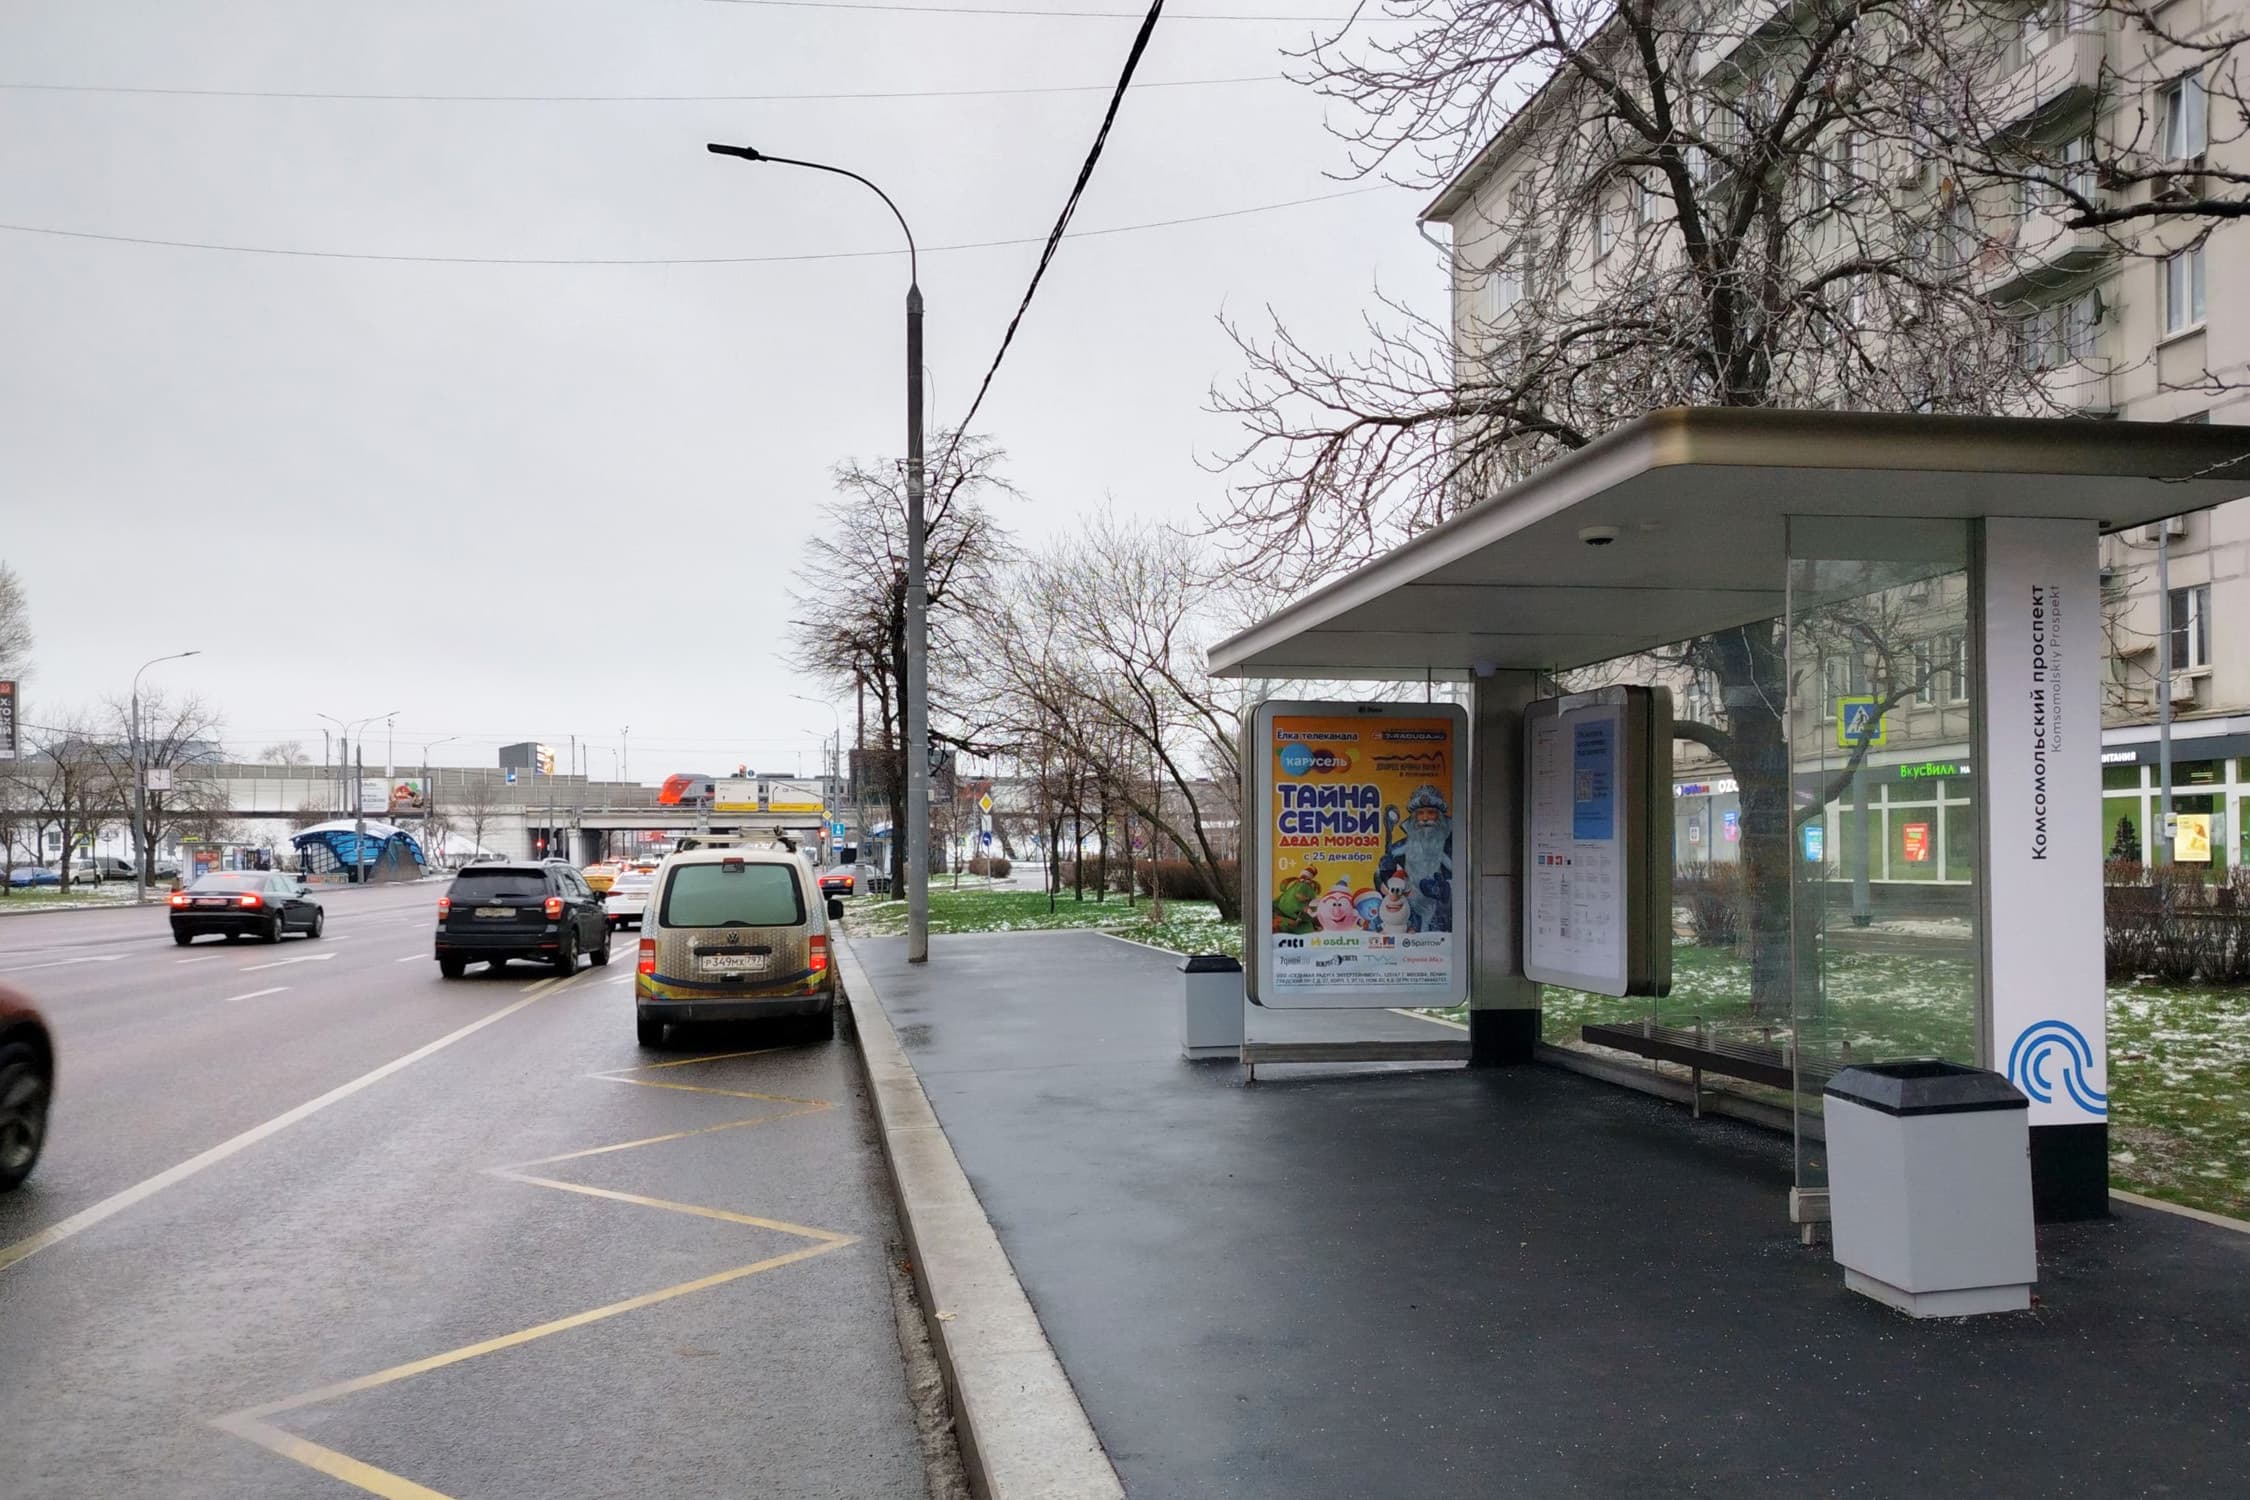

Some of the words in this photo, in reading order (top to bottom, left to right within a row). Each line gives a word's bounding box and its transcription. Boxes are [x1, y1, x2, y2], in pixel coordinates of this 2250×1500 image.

[2050, 585, 2063, 647] Prospekt
[2031, 584, 2048, 682] проспект
[2050, 650, 2063, 753] Komsomolskiy
[1302, 732, 1359, 742] телеканала
[2030, 690, 2047, 860] Комсомольский
[1277, 784, 1380, 809] ТАЙНА
[1278, 810, 1380, 834] СЕМЬИ
[1324, 836, 1380, 847] МОРОЗА
[1278, 857, 1297, 871] 0+
[1312, 852, 1326, 862] 25
[1328, 851, 1373, 863] декабря
